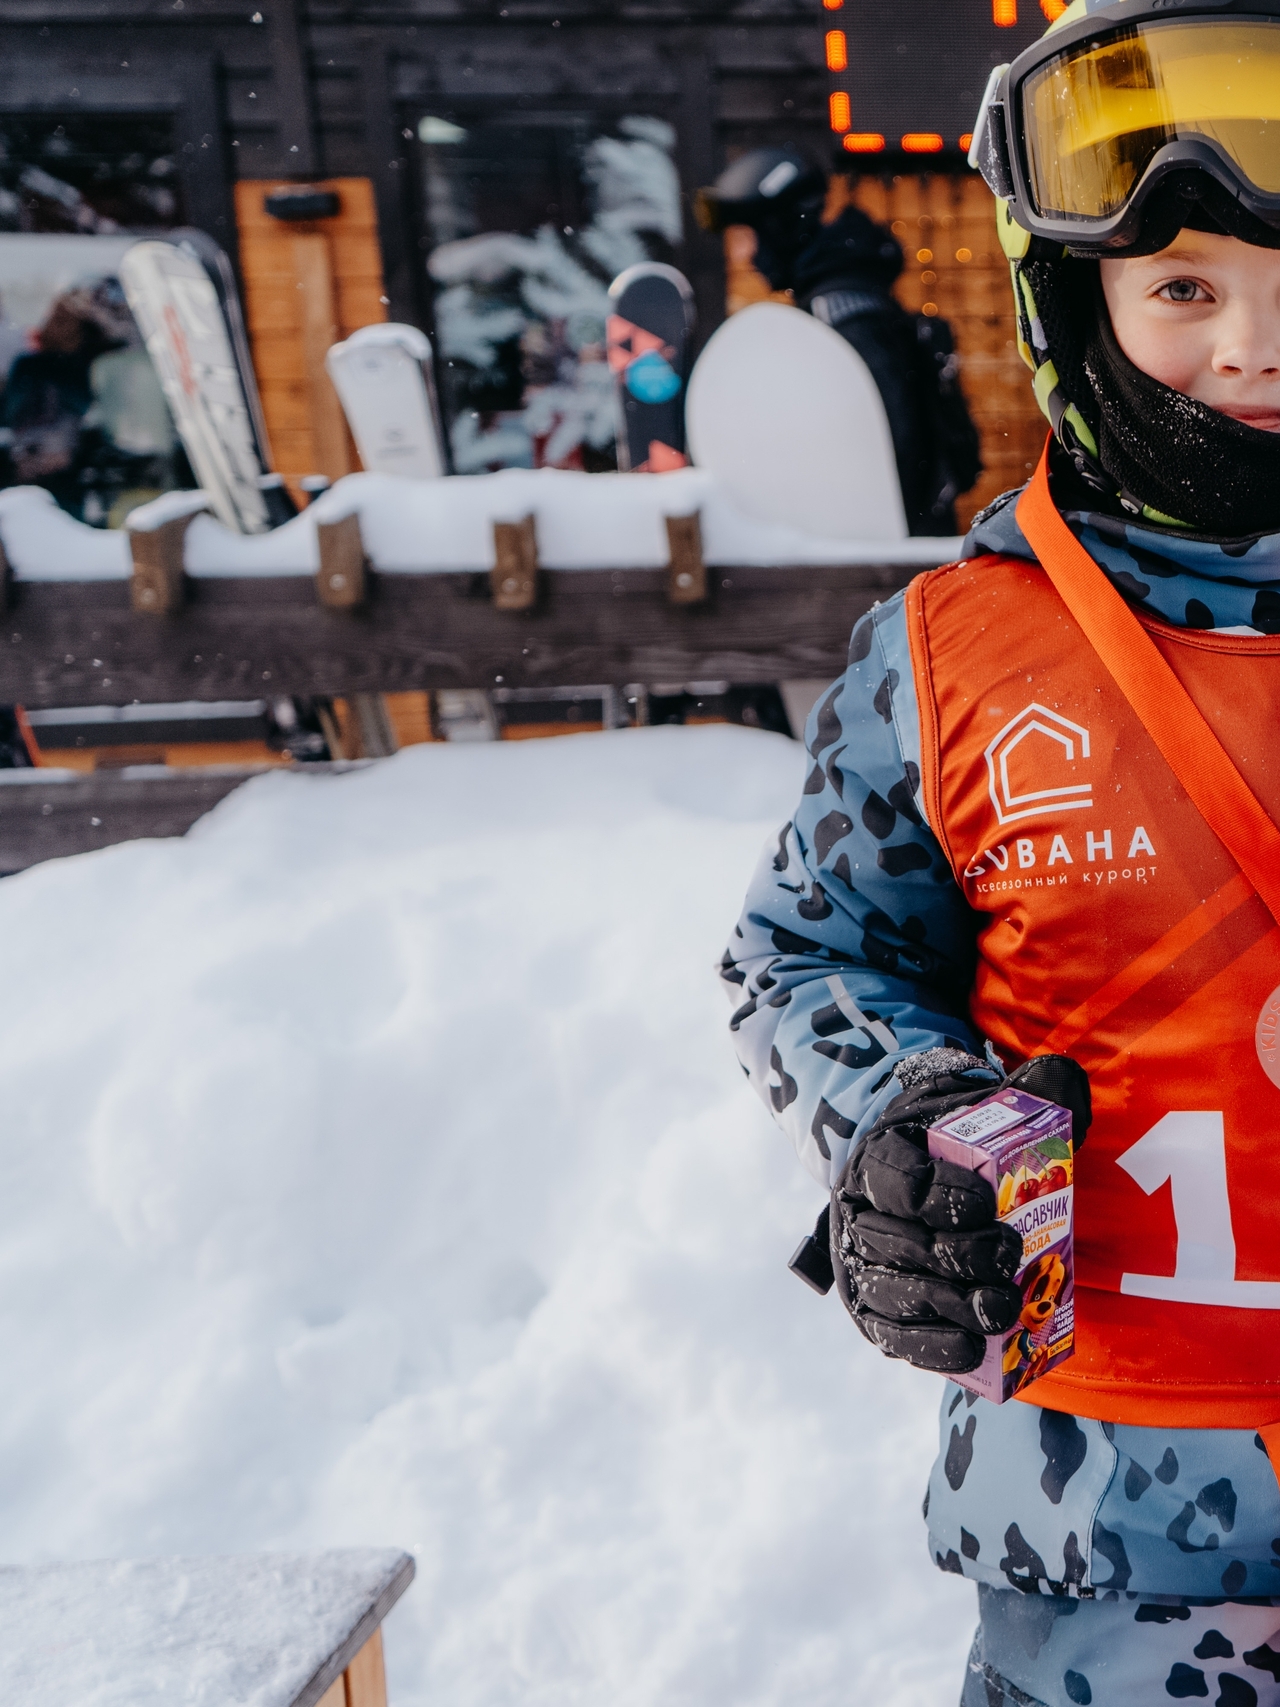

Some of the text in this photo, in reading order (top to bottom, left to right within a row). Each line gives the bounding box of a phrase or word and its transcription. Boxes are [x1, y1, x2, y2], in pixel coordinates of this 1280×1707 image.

[1082, 866, 1158, 885] курорт
[1006, 1133, 1048, 1157] ДОБАВЛЕНИЯ
[1047, 1122, 1070, 1139] САХАРА
[1012, 1195, 1070, 1237] РАСАВЧИК
[1023, 1218, 1067, 1245] ЕВО-АНАНАСОВАЯ
[1024, 1233, 1052, 1257] ВОДА
